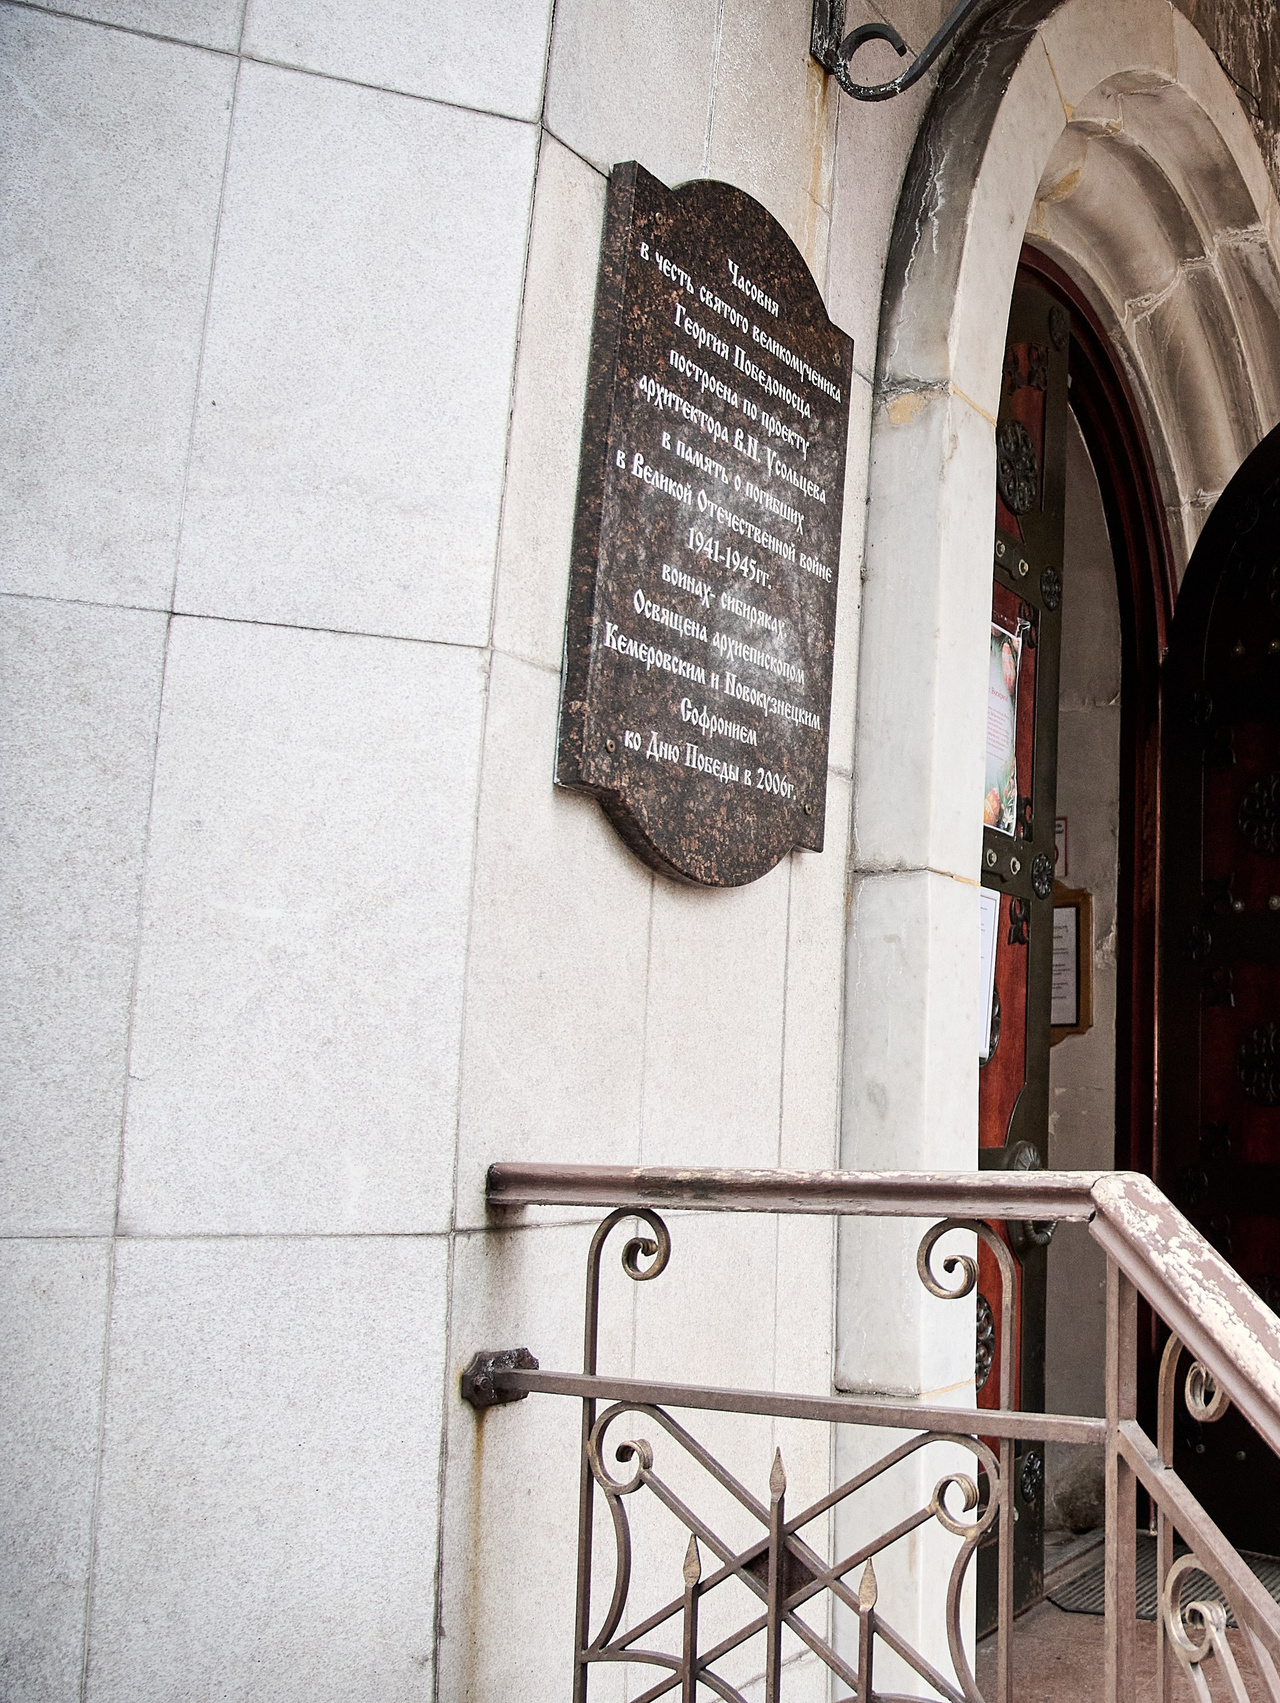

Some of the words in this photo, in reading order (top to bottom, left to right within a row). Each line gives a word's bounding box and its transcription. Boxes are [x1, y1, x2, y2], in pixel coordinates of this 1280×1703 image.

[640, 241, 650, 261] в
[655, 251, 694, 294] честь
[700, 285, 749, 334] святого
[752, 325, 841, 403] великомученика
[727, 258, 779, 318] Часовня
[669, 349, 738, 409] построена
[743, 398, 757, 421] по
[761, 411, 810, 461] проекту
[674, 302, 729, 360] Георгия
[733, 344, 811, 419] Победоносца
[639, 374, 729, 443] архитектора
[766, 446, 827, 505] Усольцева
[661, 430, 671, 451] в
[676, 440, 729, 484] память
[734, 474, 741, 492] о
[745, 481, 805, 536] погибших
[616, 449, 626, 470] в
[631, 452, 693, 506] Великой
[697, 488, 796, 563] Отечественной
[799, 552, 833, 584] войне
[687, 526, 772, 590] 1941-1945гг.
[603, 621, 706, 685] Кемеровским
[710, 672, 720, 691] и
[723, 671, 821, 731] Новокузнецким
[633, 588, 708, 643] Освящена
[712, 630, 805, 686] архиепископом
[624, 729, 642, 751] ко
[646, 730, 680, 763] Дню
[684, 741, 740, 785] Победы
[744, 769, 752, 787] в
[756, 767, 798, 801] 2006г.
[680, 697, 758, 747] Софронием
